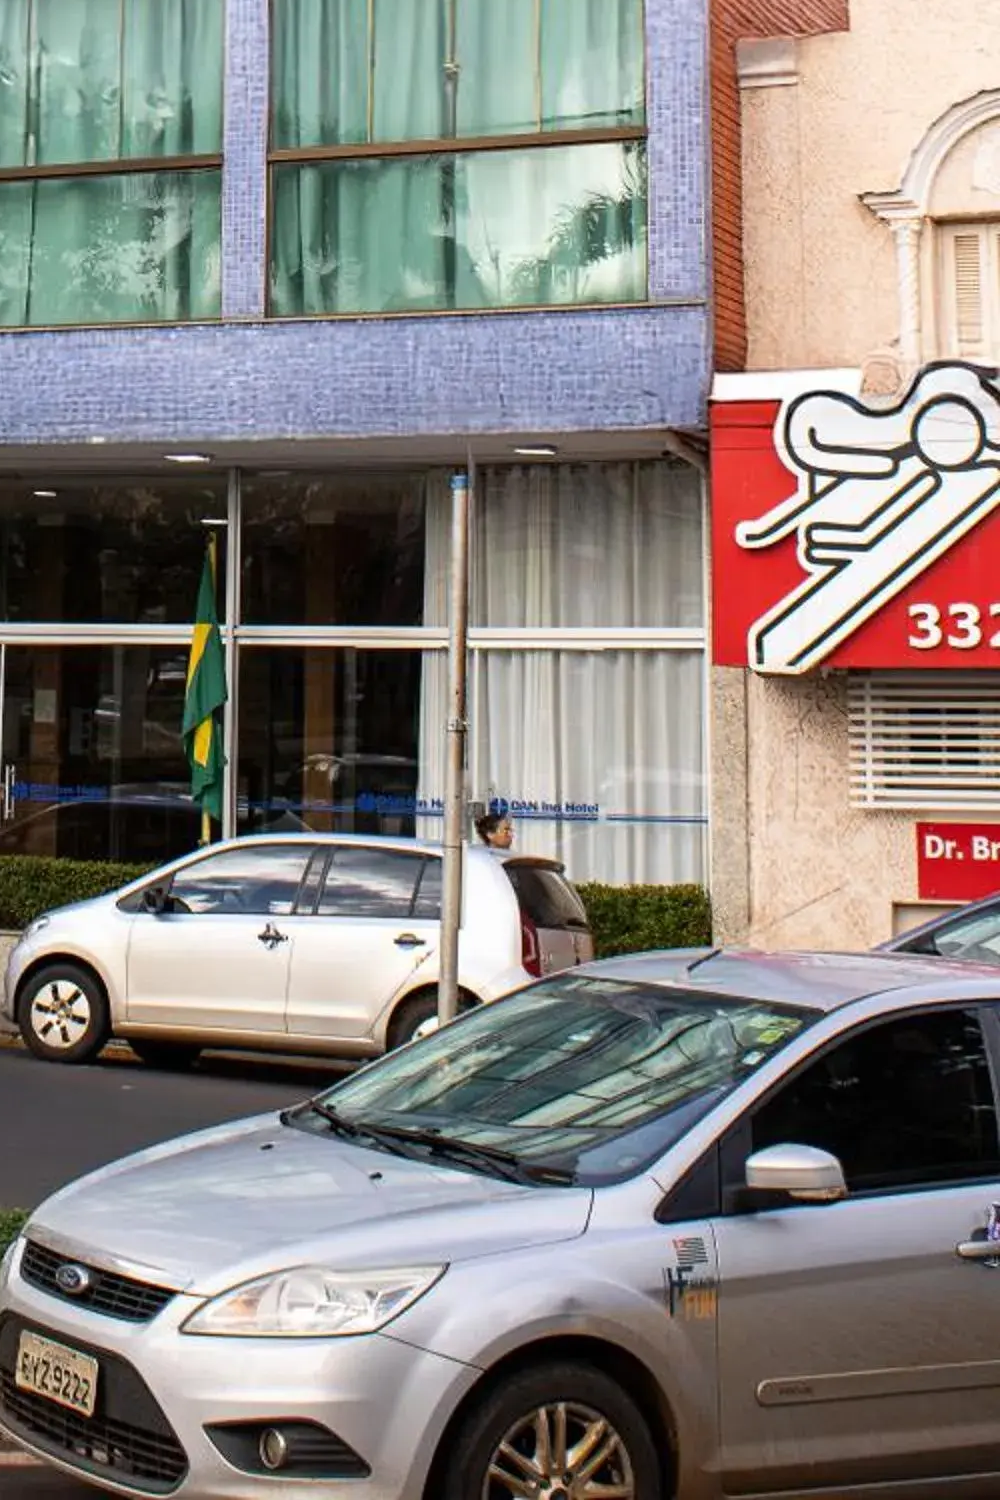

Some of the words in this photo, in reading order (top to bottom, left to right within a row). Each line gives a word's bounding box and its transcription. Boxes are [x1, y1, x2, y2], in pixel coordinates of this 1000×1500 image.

[511, 800, 538, 811] DAN
[565, 802, 599, 813] Hotel
[925, 834, 964, 860] Dr.
[972, 835, 1000, 861] Br
